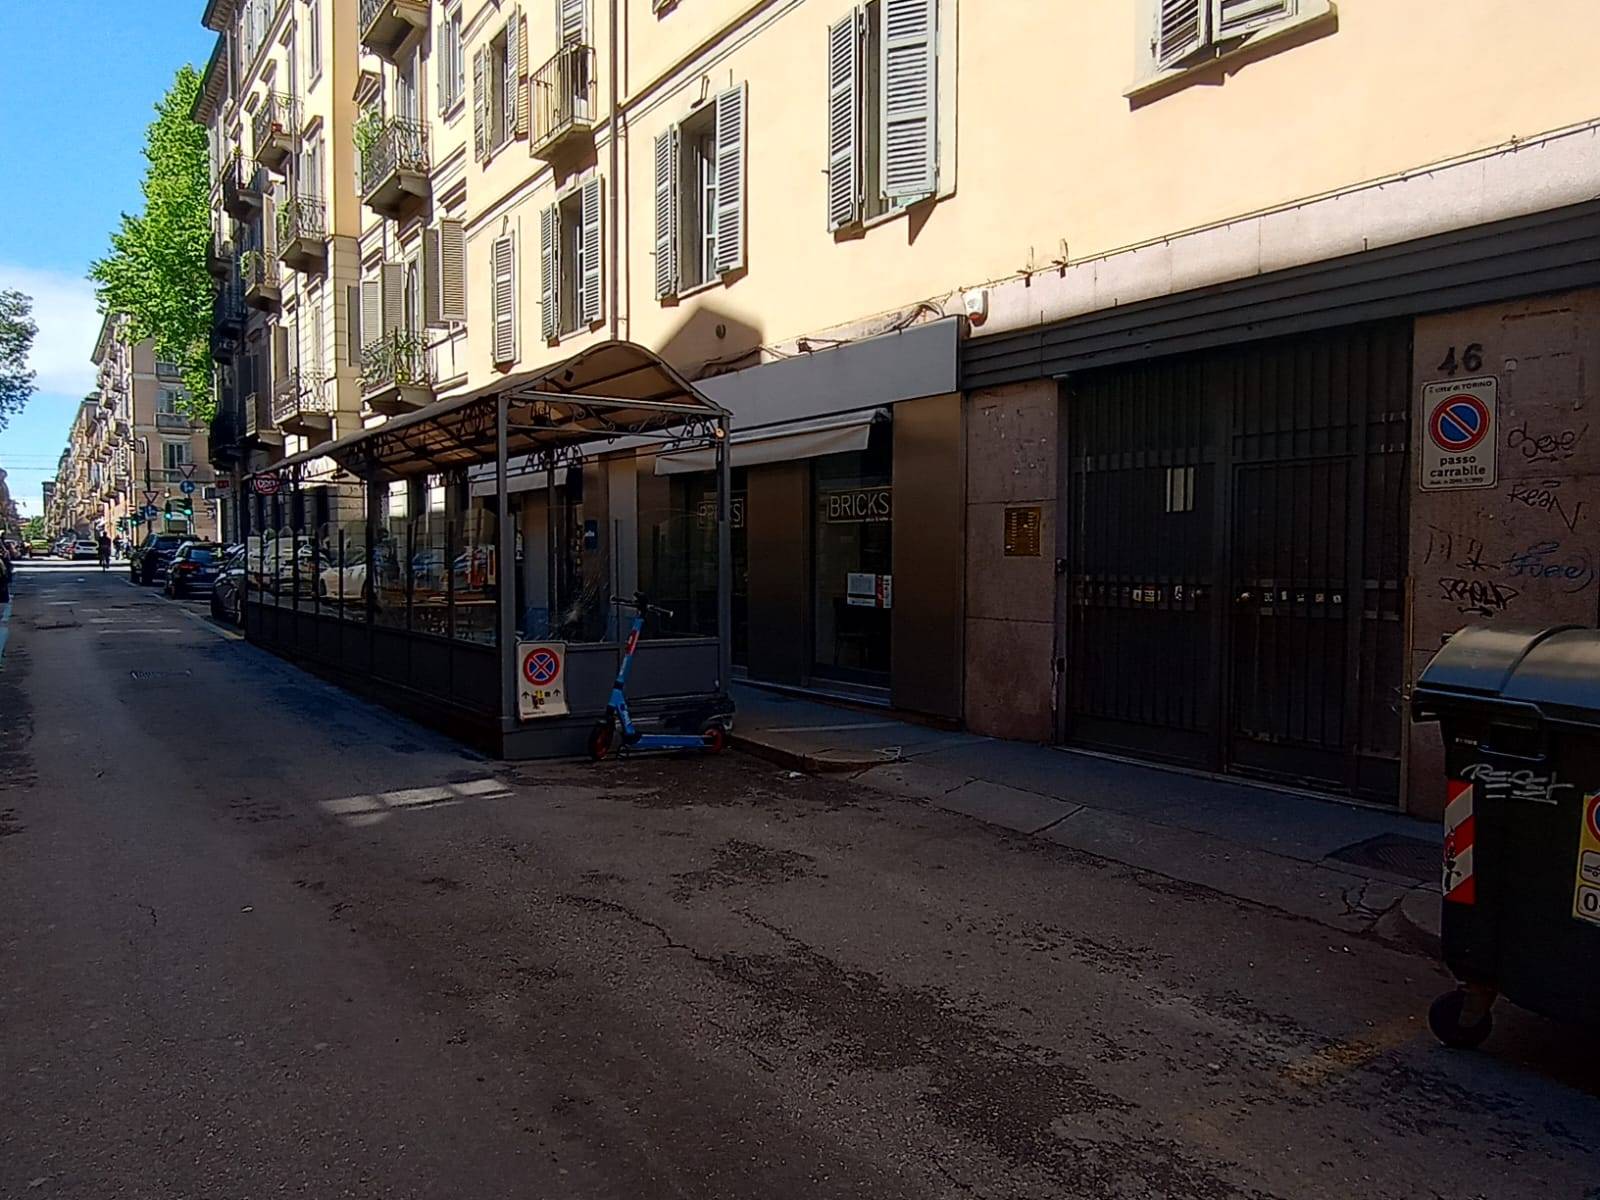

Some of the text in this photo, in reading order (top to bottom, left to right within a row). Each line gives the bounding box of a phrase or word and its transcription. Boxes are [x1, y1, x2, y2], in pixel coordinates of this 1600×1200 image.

[1437, 343, 1482, 376] 46
[1462, 380, 1492, 389] TORINO
[1440, 456, 1476, 467] passo
[1430, 466, 1486, 478] carrabile
[829, 492, 889, 518] BRICKS
